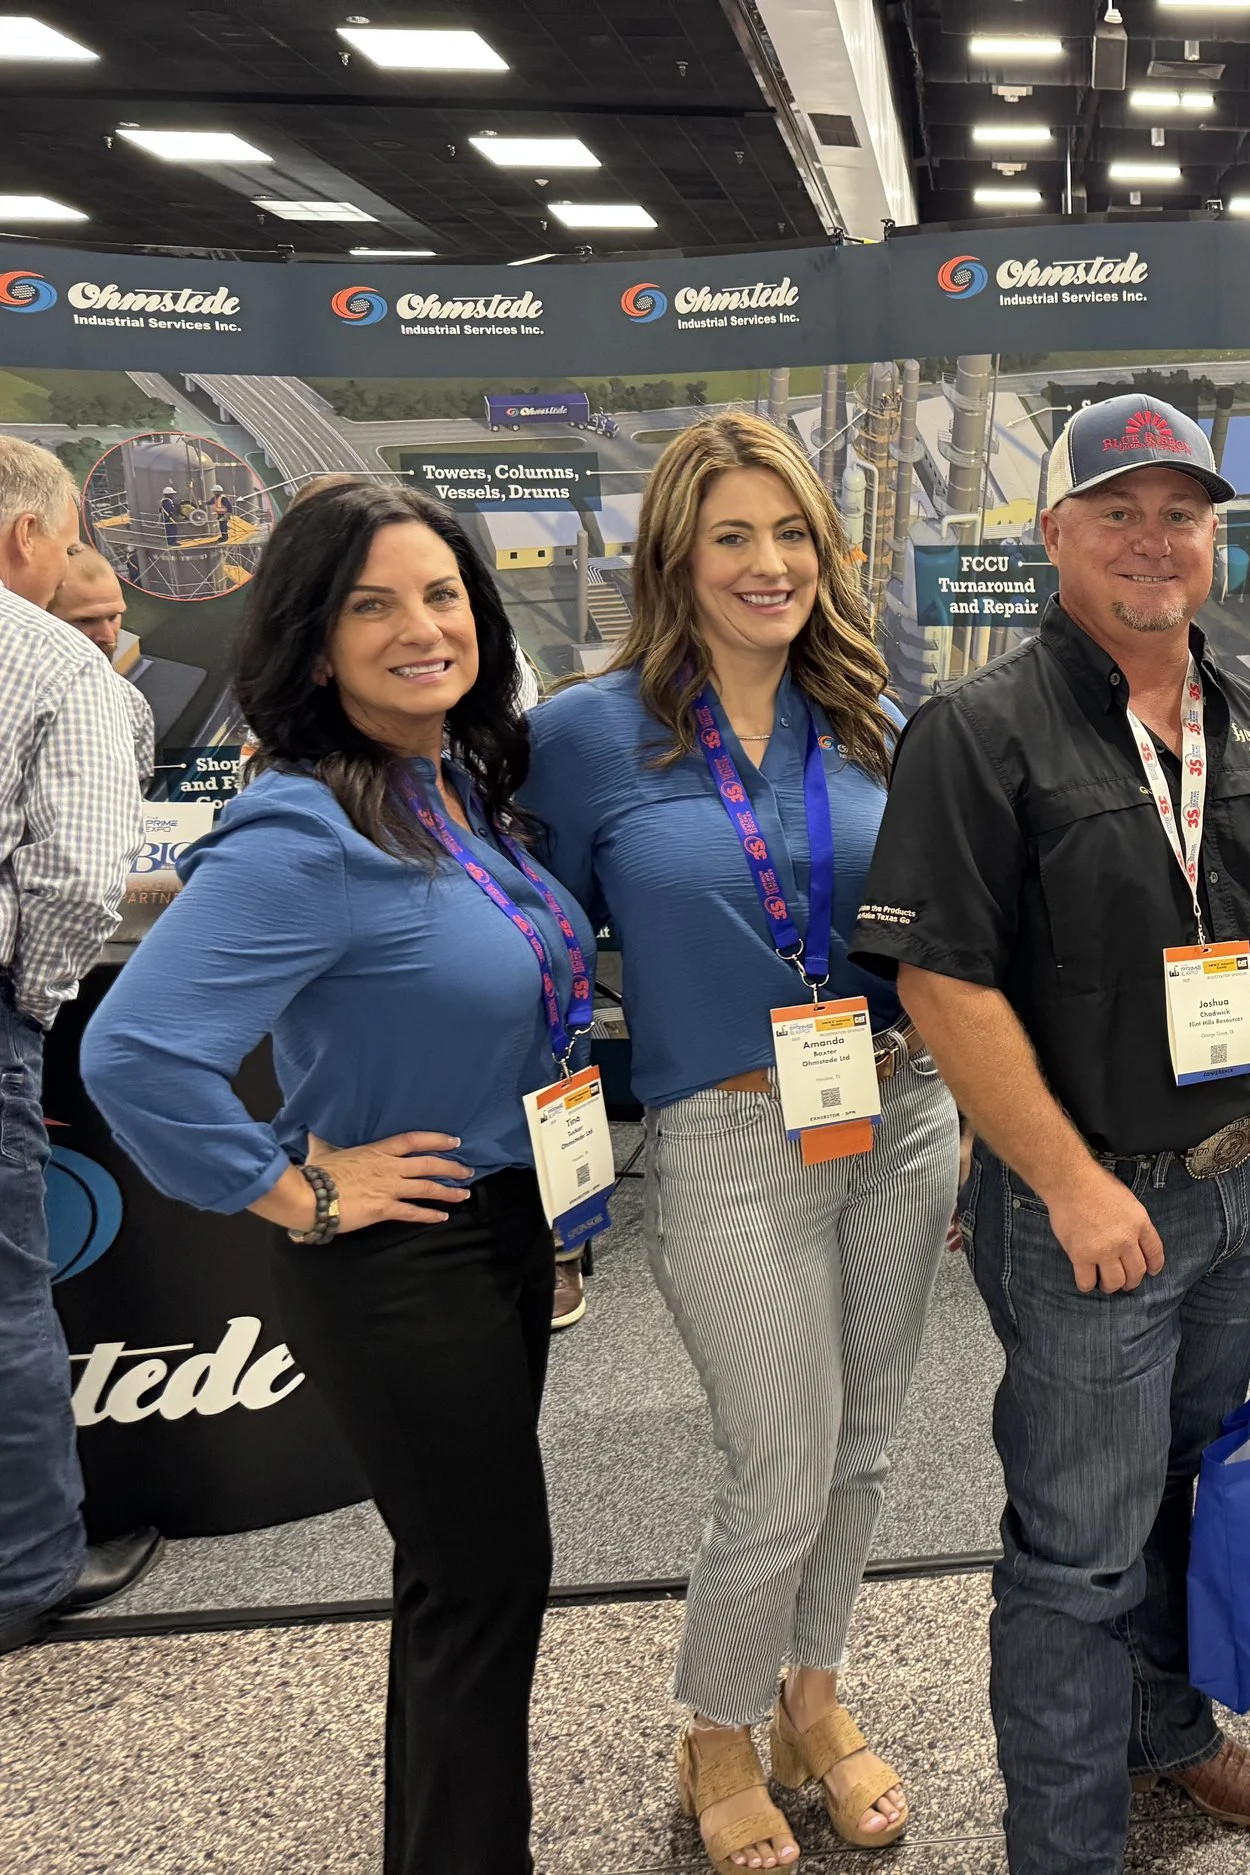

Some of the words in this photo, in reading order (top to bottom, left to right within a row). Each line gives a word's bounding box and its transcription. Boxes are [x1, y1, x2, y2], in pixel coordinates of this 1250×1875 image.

[996, 252, 1148, 289] Ohmstede
[68, 282, 241, 315] Ohmstede
[675, 277, 799, 314] Ohmstede
[1000, 293, 1058, 306] Industrial
[1062, 291, 1119, 303] Services
[1123, 290, 1147, 301] Inc.
[396, 291, 543, 319] Ohmstede
[73, 314, 145, 327] Industrial
[149, 317, 211, 330] Services
[215, 321, 242, 332] Inc.
[678, 316, 727, 329] Industrial
[730, 314, 776, 326] Services
[779, 313, 799, 323] Inc.
[401, 325, 460, 335] Industrial
[464, 324, 517, 335] Services
[521, 325, 544, 335] Inc.
[520, 405, 568, 416] Ohmstede
[423, 464, 492, 482] Towers,
[495, 464, 580, 482] Columns,
[435, 485, 506, 501] Vessels,
[508, 485, 570, 499] Drums
[961, 557, 1009, 572] FCCU
[939, 578, 1036, 593] Turnaround
[949, 601, 980, 614] and
[982, 601, 1039, 616] Repair
[195, 757, 240, 772] Shop
[181, 777, 219, 791] and
[877, 913, 898, 922] Texas
[883, 905, 916, 917] Products
[1199, 999, 1229, 1008] Joshua
[1200, 1009, 1230, 1017] Chadwick
[803, 1036, 845, 1049] Amanda
[814, 1049, 837, 1057] Baxter
[802, 1057, 838, 1067] Ohmstede
[1203, 1068, 1233, 1077] CONFERENCE
[566, 1116, 580, 1127] Tina
[810, 1113, 840, 1122] EXHIBITOR
[70, 1316, 306, 1426] tede
